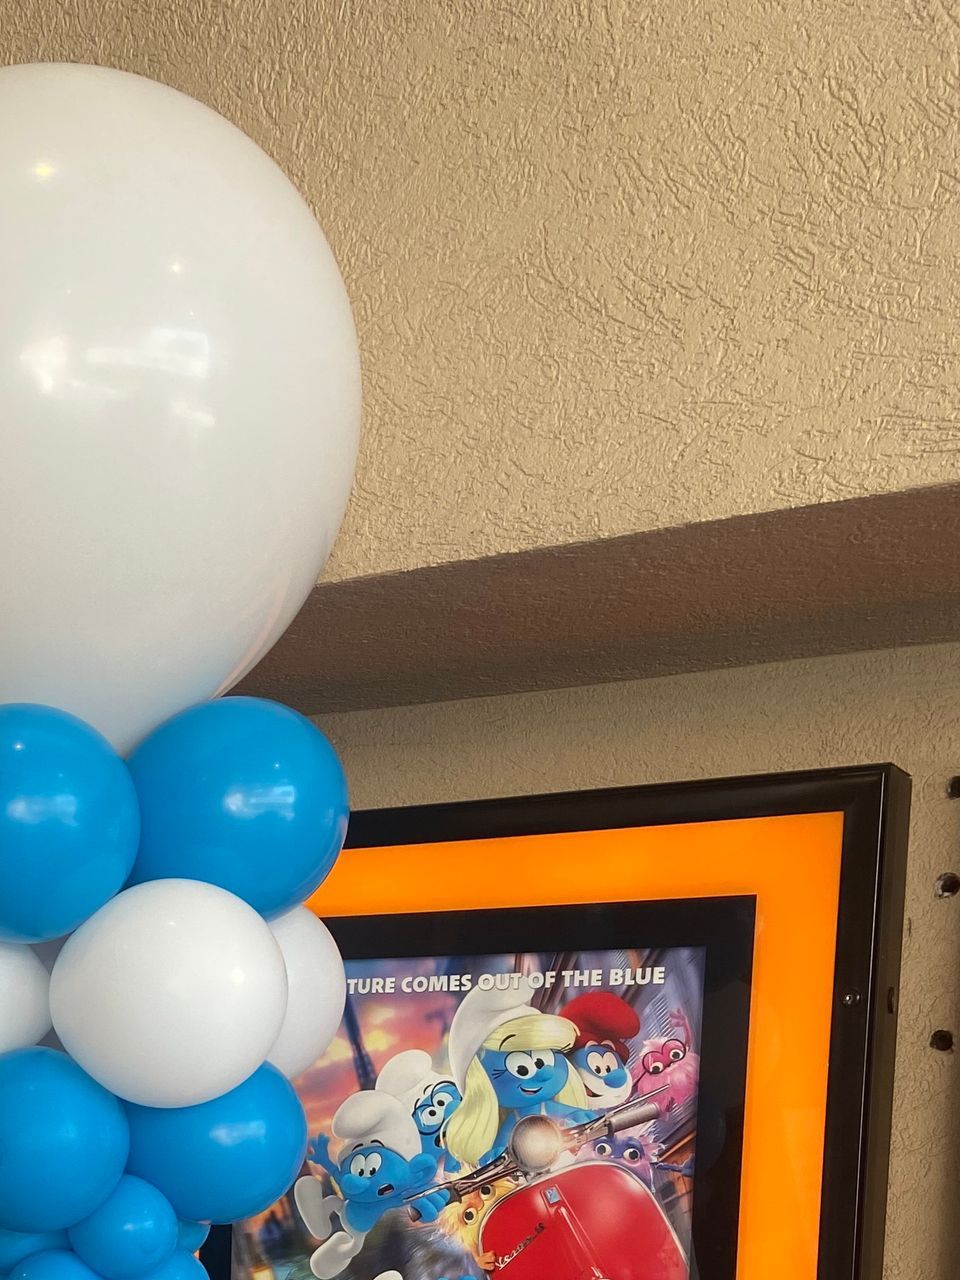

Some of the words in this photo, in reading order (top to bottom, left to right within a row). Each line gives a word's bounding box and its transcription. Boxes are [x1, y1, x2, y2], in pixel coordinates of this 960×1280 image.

[347, 976, 396, 995] TURE
[400, 974, 473, 994] COMES
[477, 972, 524, 991] OUT
[528, 970, 557, 989] OF
[562, 968, 603, 989] THE
[608, 966, 666, 986] BLUE
